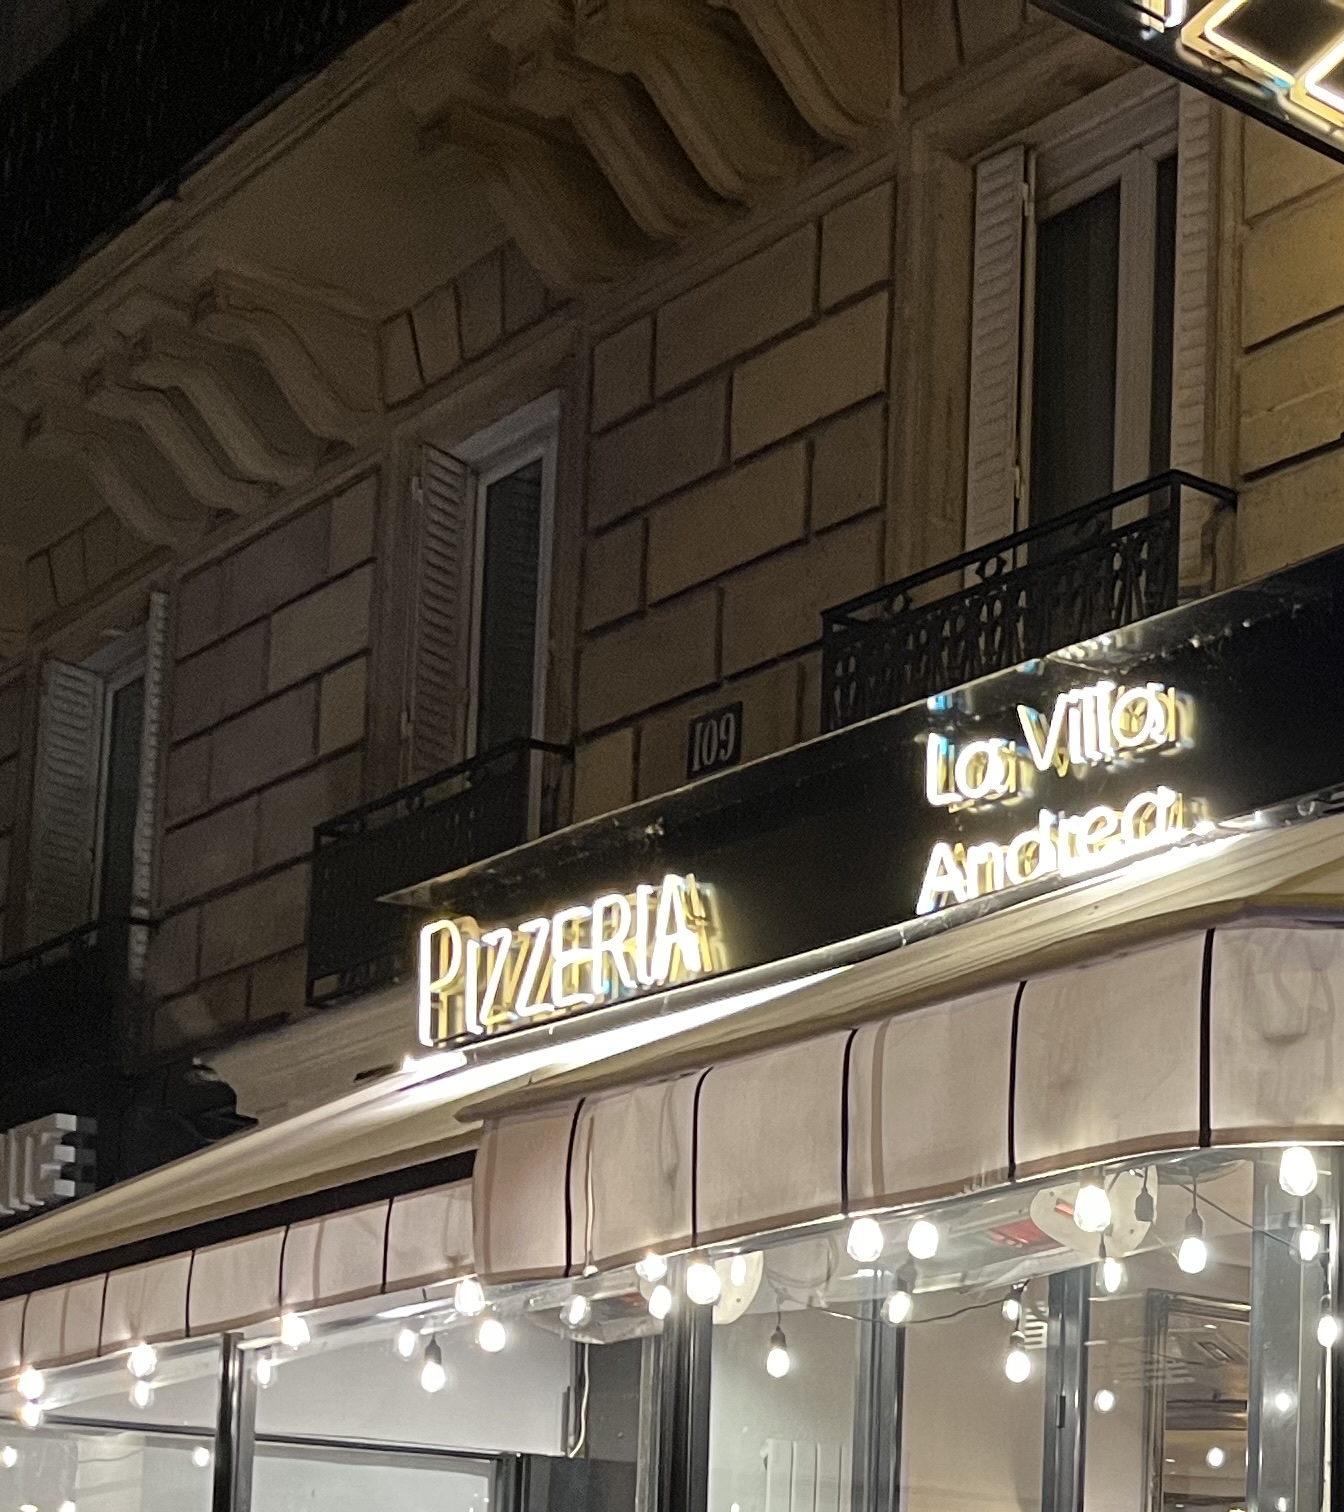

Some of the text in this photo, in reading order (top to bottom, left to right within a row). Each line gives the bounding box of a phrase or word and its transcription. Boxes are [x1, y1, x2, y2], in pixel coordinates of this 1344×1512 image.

[692, 712, 735, 771] 109
[924, 680, 1195, 808] La Villa
[915, 784, 1185, 916] Andrea
[418, 871, 724, 1048] PIZZERIA
